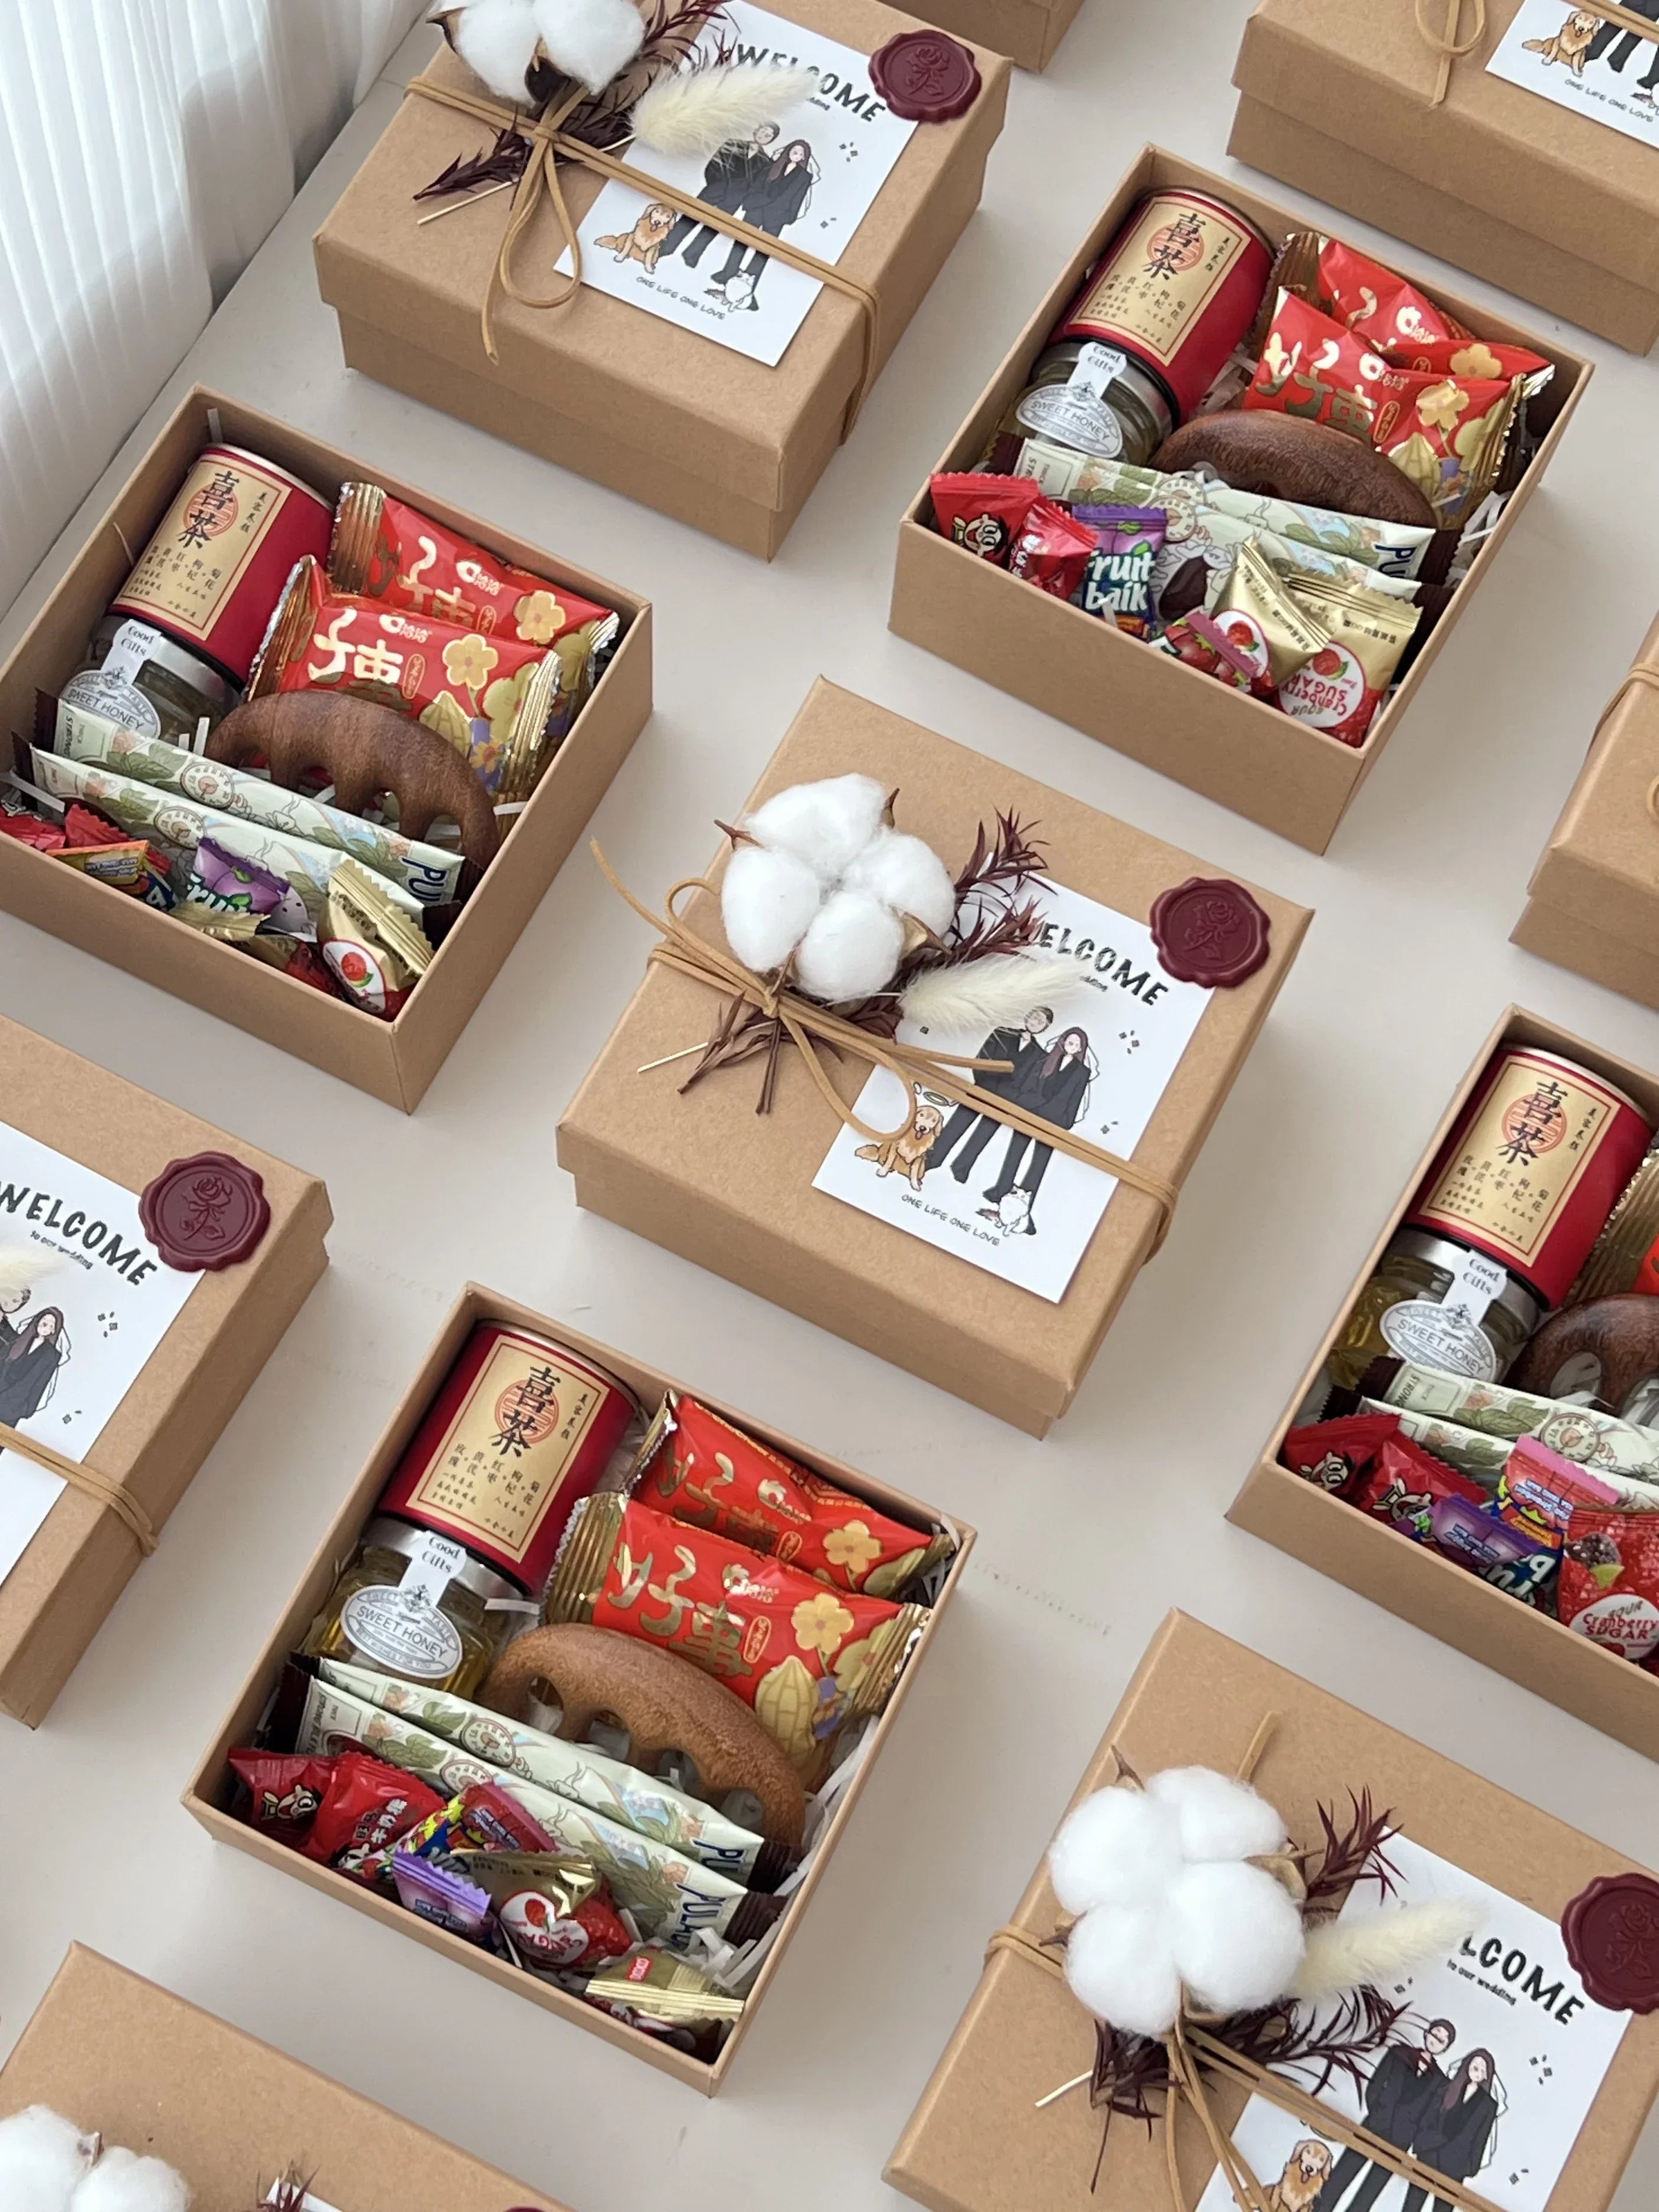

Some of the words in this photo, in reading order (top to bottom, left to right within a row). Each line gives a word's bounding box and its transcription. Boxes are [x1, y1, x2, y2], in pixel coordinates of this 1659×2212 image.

[738, 44, 885, 122] WEOME
[1565, 78, 1584, 90] ONE
[1585, 87, 1606, 102] LIFE
[1608, 99, 1627, 111] ONE
[1629, 107, 1654, 122] LOVE
[1143, 212, 1207, 281] 喜茶
[636, 277, 655, 288] ONE
[656, 285, 679, 298] LIFE
[680, 296, 699, 308] ONE
[701, 305, 726, 320] LOVE
[1031, 400, 1070, 422] SWEET
[1071, 410, 1111, 442] HONEY
[176, 471, 240, 549] 喜茶
[101, 703, 145, 730] HONEY
[1039, 922, 1169, 1006] ELCOME
[1497, 1081, 1569, 1167] 喜茶
[901, 1194, 923, 1209] ONE
[924, 1204, 948, 1221] LIFE
[949, 1218, 971, 1232] ONE
[973, 1228, 1000, 1246] LOVE
[1462, 1271, 1494, 1297] Gifts
[1467, 1258, 1501, 1284] Good
[1396, 1318, 1447, 1352] SWEET
[1444, 1338, 1485, 1374] HONEY
[489, 1366, 561, 1458] 喜茶
[421, 1550, 452, 1575] Gifts
[427, 1536, 460, 1560] Good
[356, 1605, 404, 1635] SWEET
[403, 1622, 449, 1658] HONEY
[1582, 1613, 1659, 1629] Cranberry
[1585, 1625, 1648, 1640] SUGAR
[1458, 1967, 1476, 1980] our
[1477, 1977, 1517, 2006] wedding
[1459, 1936, 1585, 2025] LCOME
